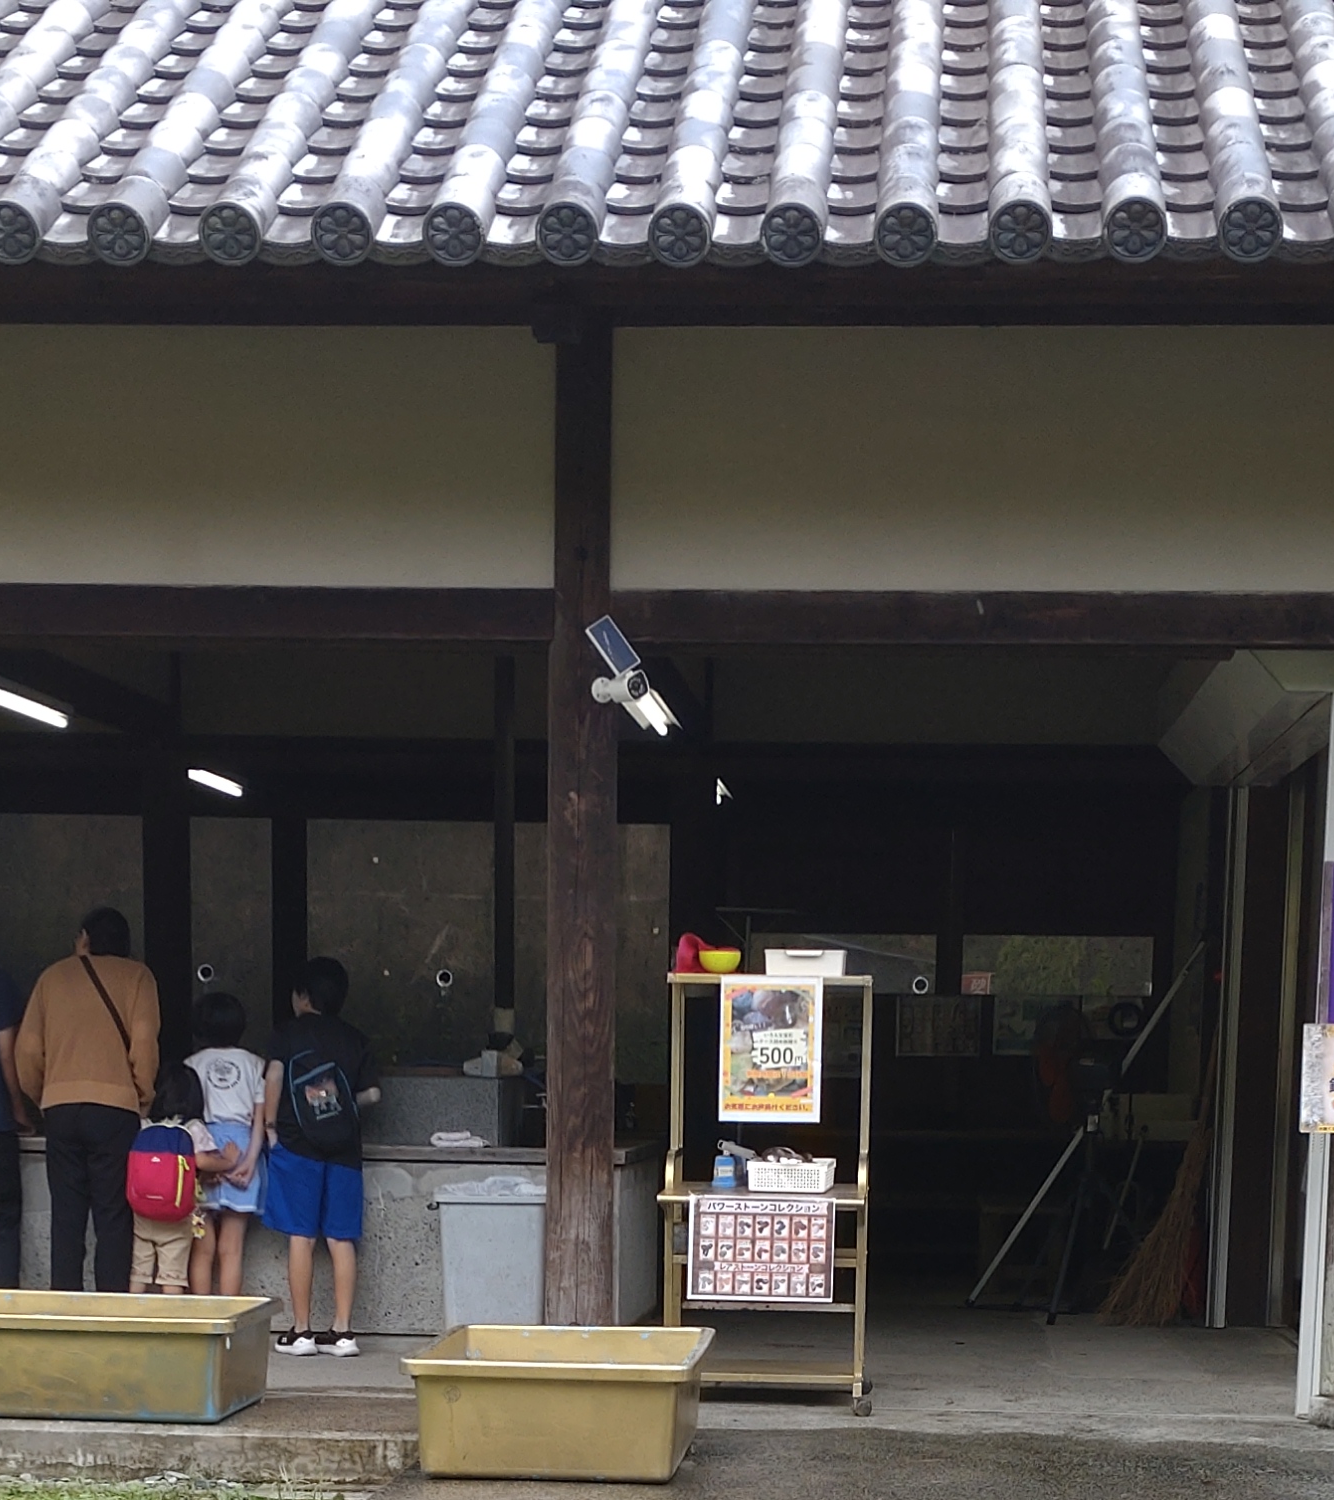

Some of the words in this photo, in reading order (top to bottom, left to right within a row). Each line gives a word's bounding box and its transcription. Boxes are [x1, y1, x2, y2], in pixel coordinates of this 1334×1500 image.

[707, 1202, 820, 1213] パワーストーンコレクション
